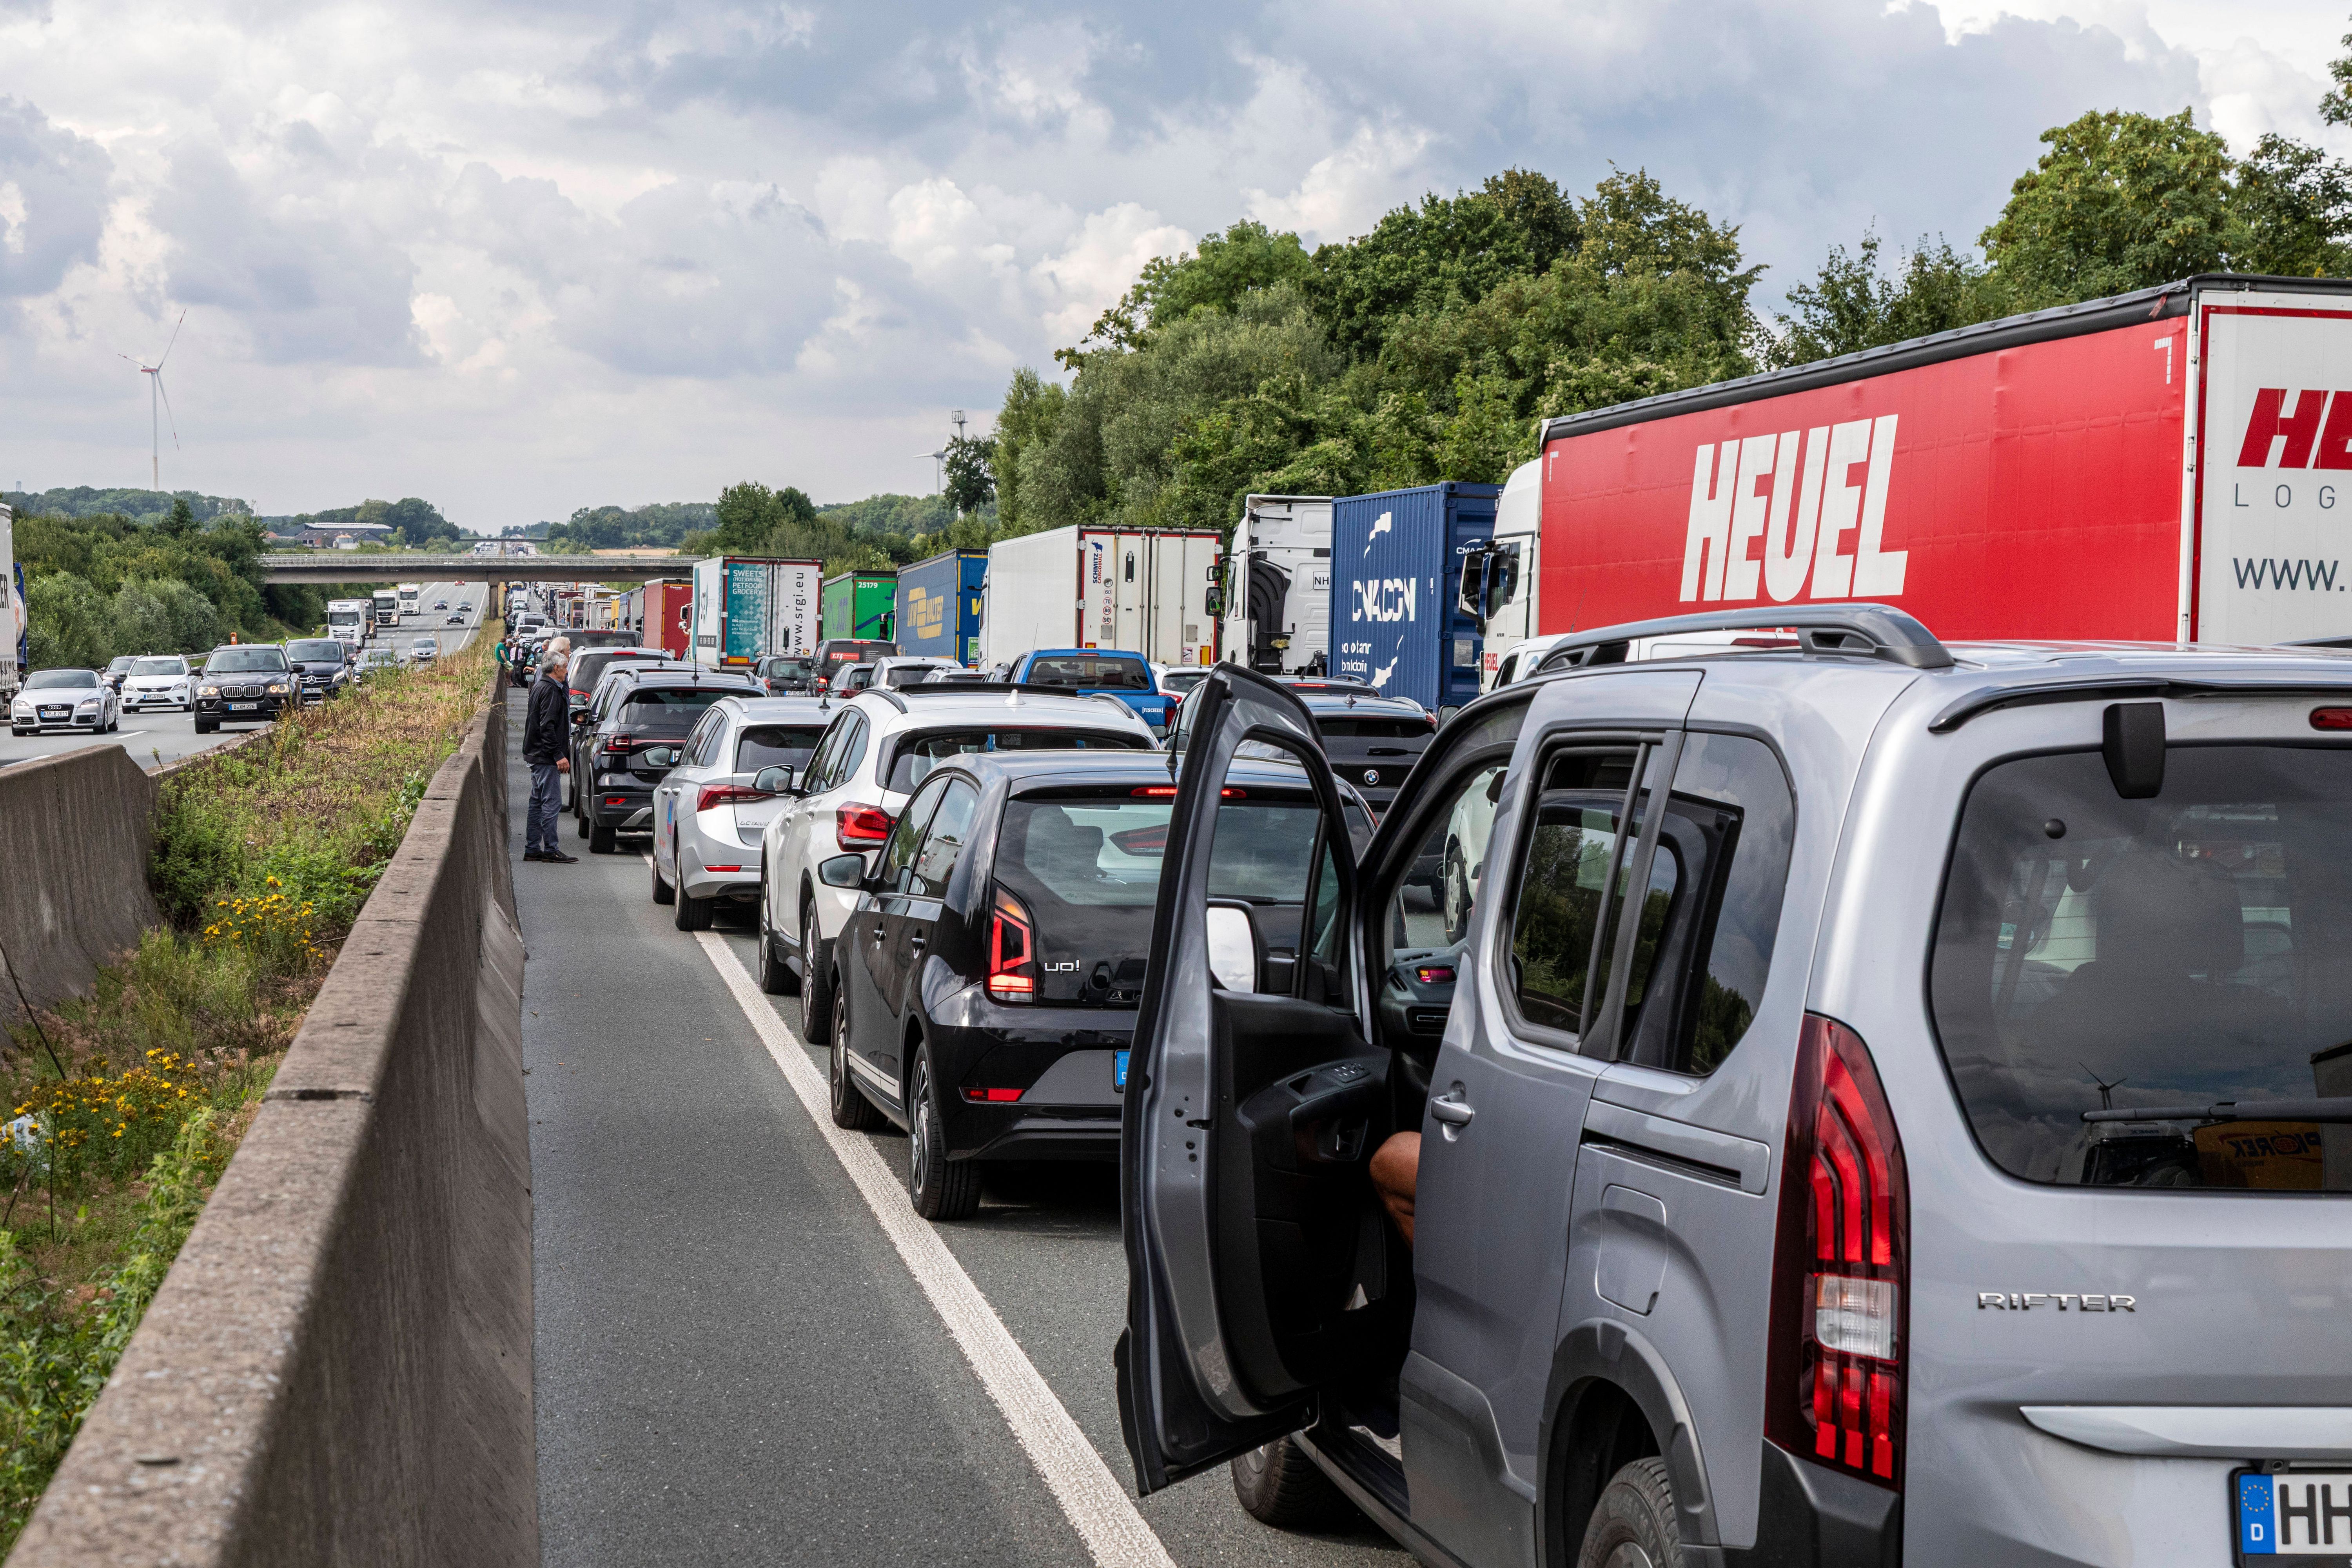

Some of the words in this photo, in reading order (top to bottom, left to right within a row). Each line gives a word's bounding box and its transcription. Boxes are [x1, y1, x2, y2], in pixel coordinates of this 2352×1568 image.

[1679, 414, 1908, 602] HEUEL
[793, 572, 806, 655] www.srgi.eu
[1485, 653, 1498, 671] HEUEL
[1044, 960, 1080, 975] up!
[1978, 1292, 2136, 1312] RIFTER
[2279, 1484, 2352, 1545] HH
[2250, 1523, 2264, 1541] D
